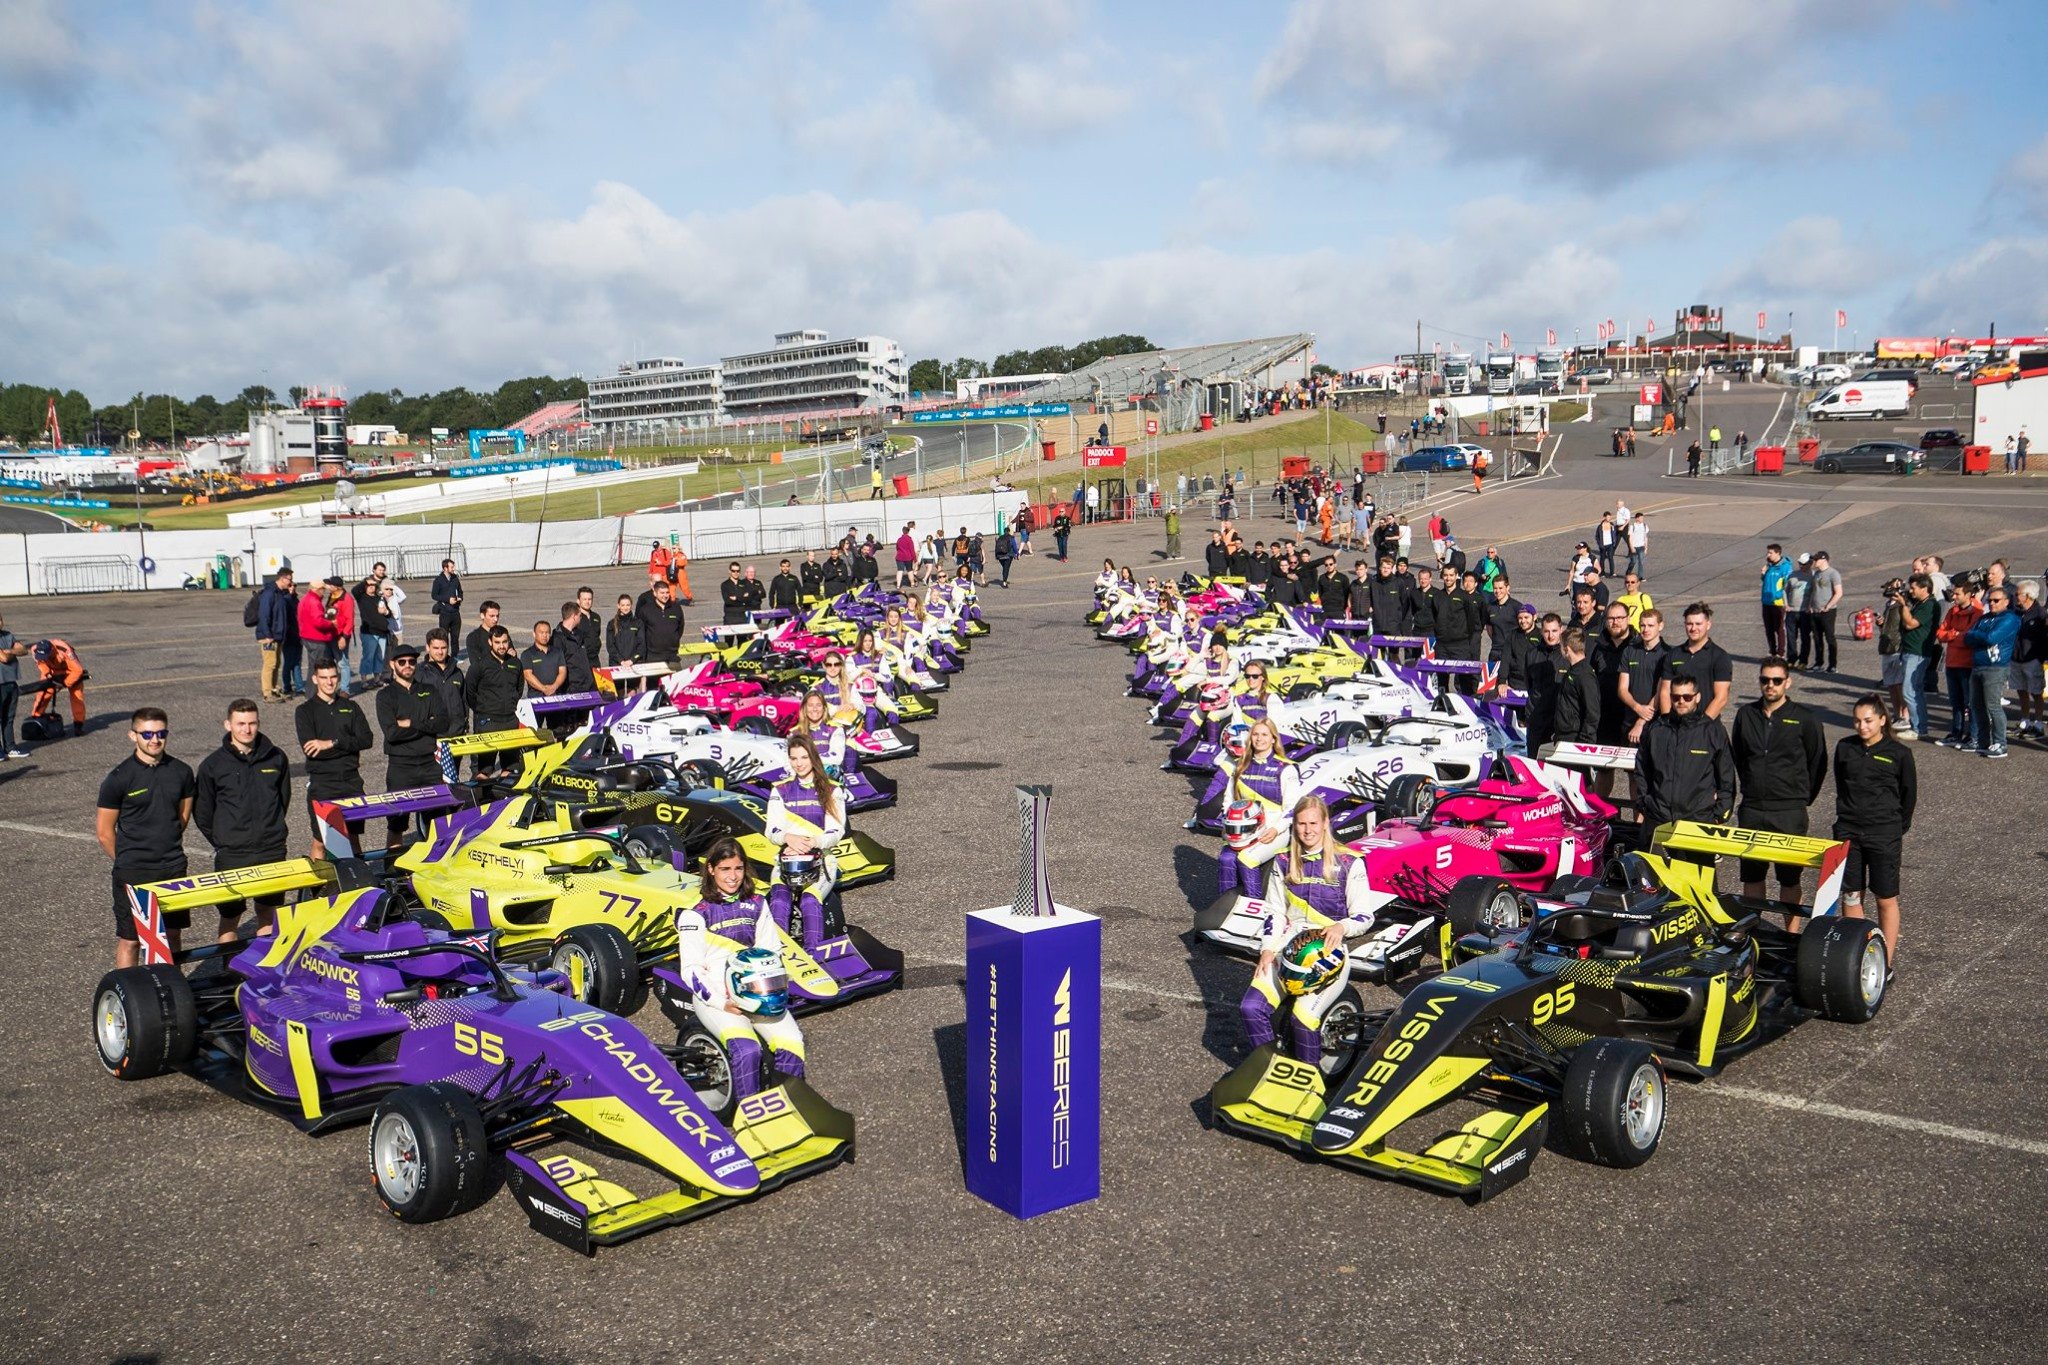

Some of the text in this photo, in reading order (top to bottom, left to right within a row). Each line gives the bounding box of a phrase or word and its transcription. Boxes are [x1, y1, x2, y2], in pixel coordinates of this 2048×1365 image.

[1087, 448, 1114, 457] PADDOCK
[1087, 458, 1101, 466] EXIT
[773, 641, 796, 650] WOOD
[737, 659, 762, 670] COOK
[1281, 675, 1301, 689] 27
[683, 686, 713, 699] GARCIA
[1381, 687, 1410, 698] HAWKINS
[757, 703, 778, 719] 19
[1319, 710, 1338, 726] 21
[1454, 726, 1492, 743] MOORE
[709, 744, 722, 760] 3
[1197, 742, 1217, 754] 21
[1376, 757, 1404, 777] 26
[551, 773, 599, 791] HOLBROOK
[364, 786, 438, 805] SERIES
[587, 790, 599, 798] 67
[656, 802, 689, 824] 67
[831, 842, 852, 856] 67
[1731, 830, 1827, 851] SERIES
[468, 848, 525, 870] KESZTHELYI
[1436, 844, 1453, 869] 5
[198, 862, 295, 887] SERIES
[511, 869, 525, 880] 77
[599, 889, 643, 919] 77
[1245, 901, 1264, 915] 5
[1650, 908, 1700, 945] VISSER
[816, 939, 849, 959] 77
[1693, 933, 1705, 948] 95
[300, 953, 360, 987] CHADWICK
[345, 986, 361, 1002] 55
[1436, 976, 1499, 994] 95
[1532, 981, 1577, 1026] 95
[537, 1011, 607, 1032] 55
[454, 1021, 505, 1066] 55
[1344, 995, 1458, 1107] VISSER
[989, 963, 997, 1164] #RETHINKRACING
[1052, 966, 1071, 1170] W SERIES
[1271, 1061, 1315, 1087] 95
[580, 1022, 723, 1148] CHADWICK
[741, 1091, 787, 1120] 55
[543, 1203, 583, 1229] SERIES
